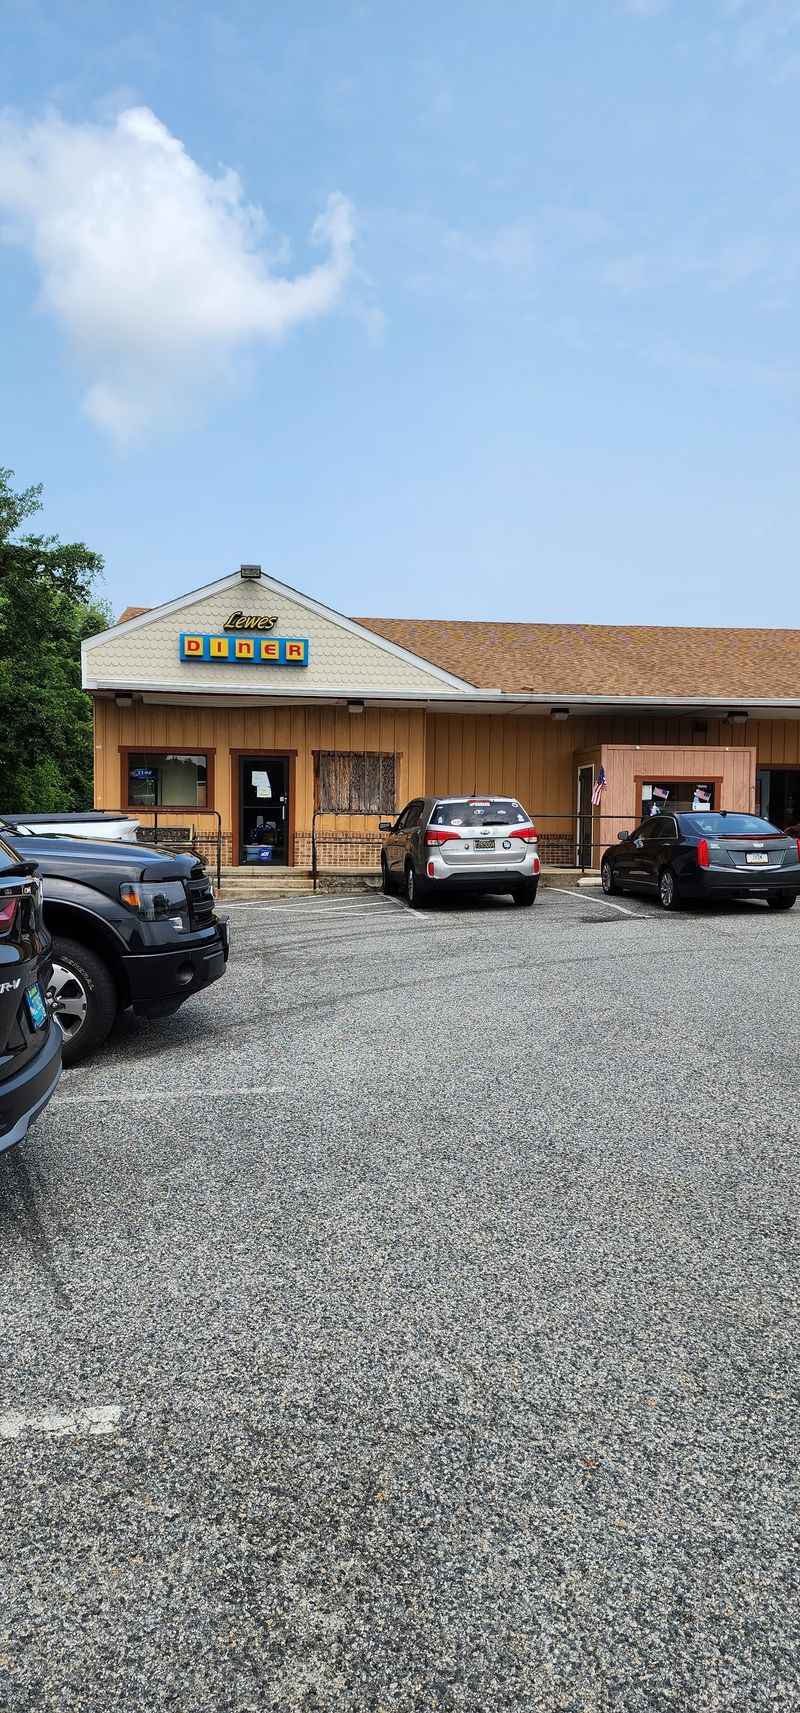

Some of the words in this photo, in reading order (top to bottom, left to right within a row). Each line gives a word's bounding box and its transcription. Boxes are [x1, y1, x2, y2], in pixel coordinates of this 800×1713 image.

[224, 610, 278, 630] Lewes
[186, 638, 302, 659] DINER
[0, 978, 21, 994] R-V
